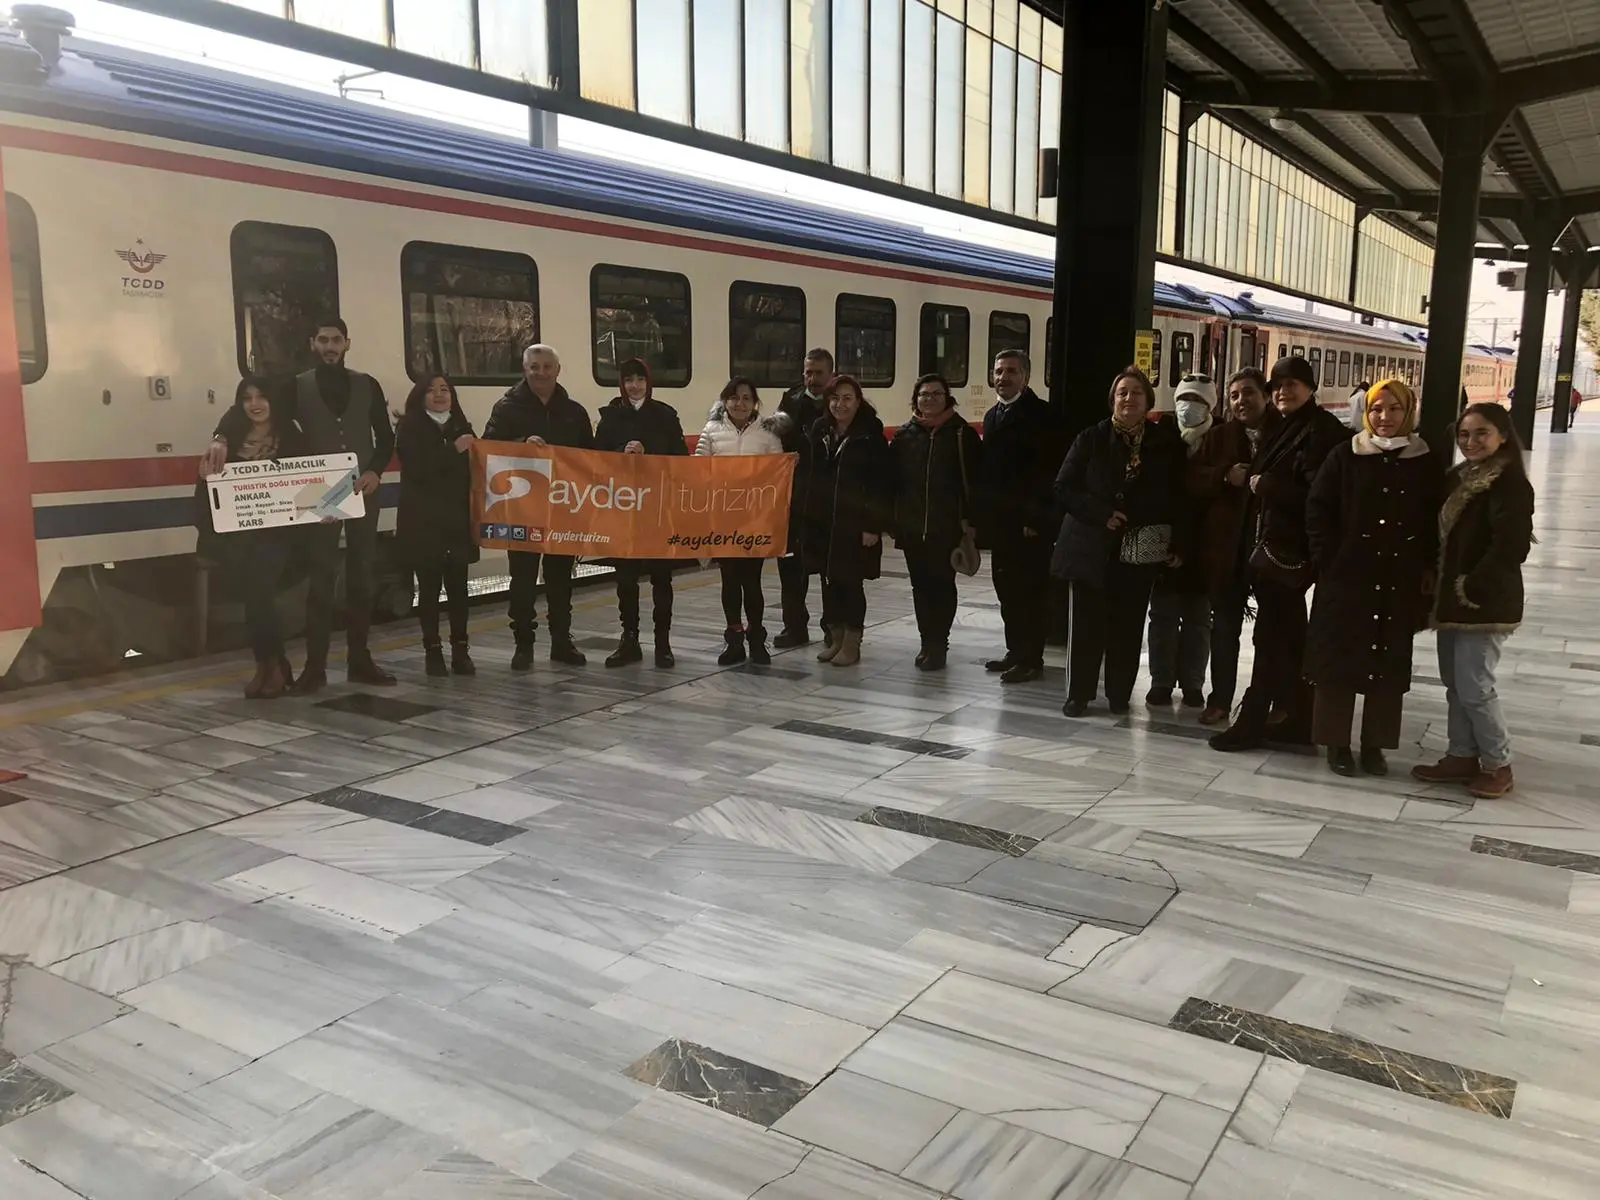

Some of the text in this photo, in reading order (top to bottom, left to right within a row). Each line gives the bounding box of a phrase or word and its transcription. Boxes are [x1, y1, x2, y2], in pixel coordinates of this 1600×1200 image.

[121, 277, 165, 290] TCDD
[154, 378, 166, 397] 6
[231, 459, 326, 475] TCDD TAŞIMACILIK
[234, 491, 271, 502] ANKARA
[549, 477, 777, 514] ayder turizm
[238, 518, 264, 528] KARS
[546, 529, 611, 544] /ayderturizm
[667, 530, 772, 550] #ayderlegez
